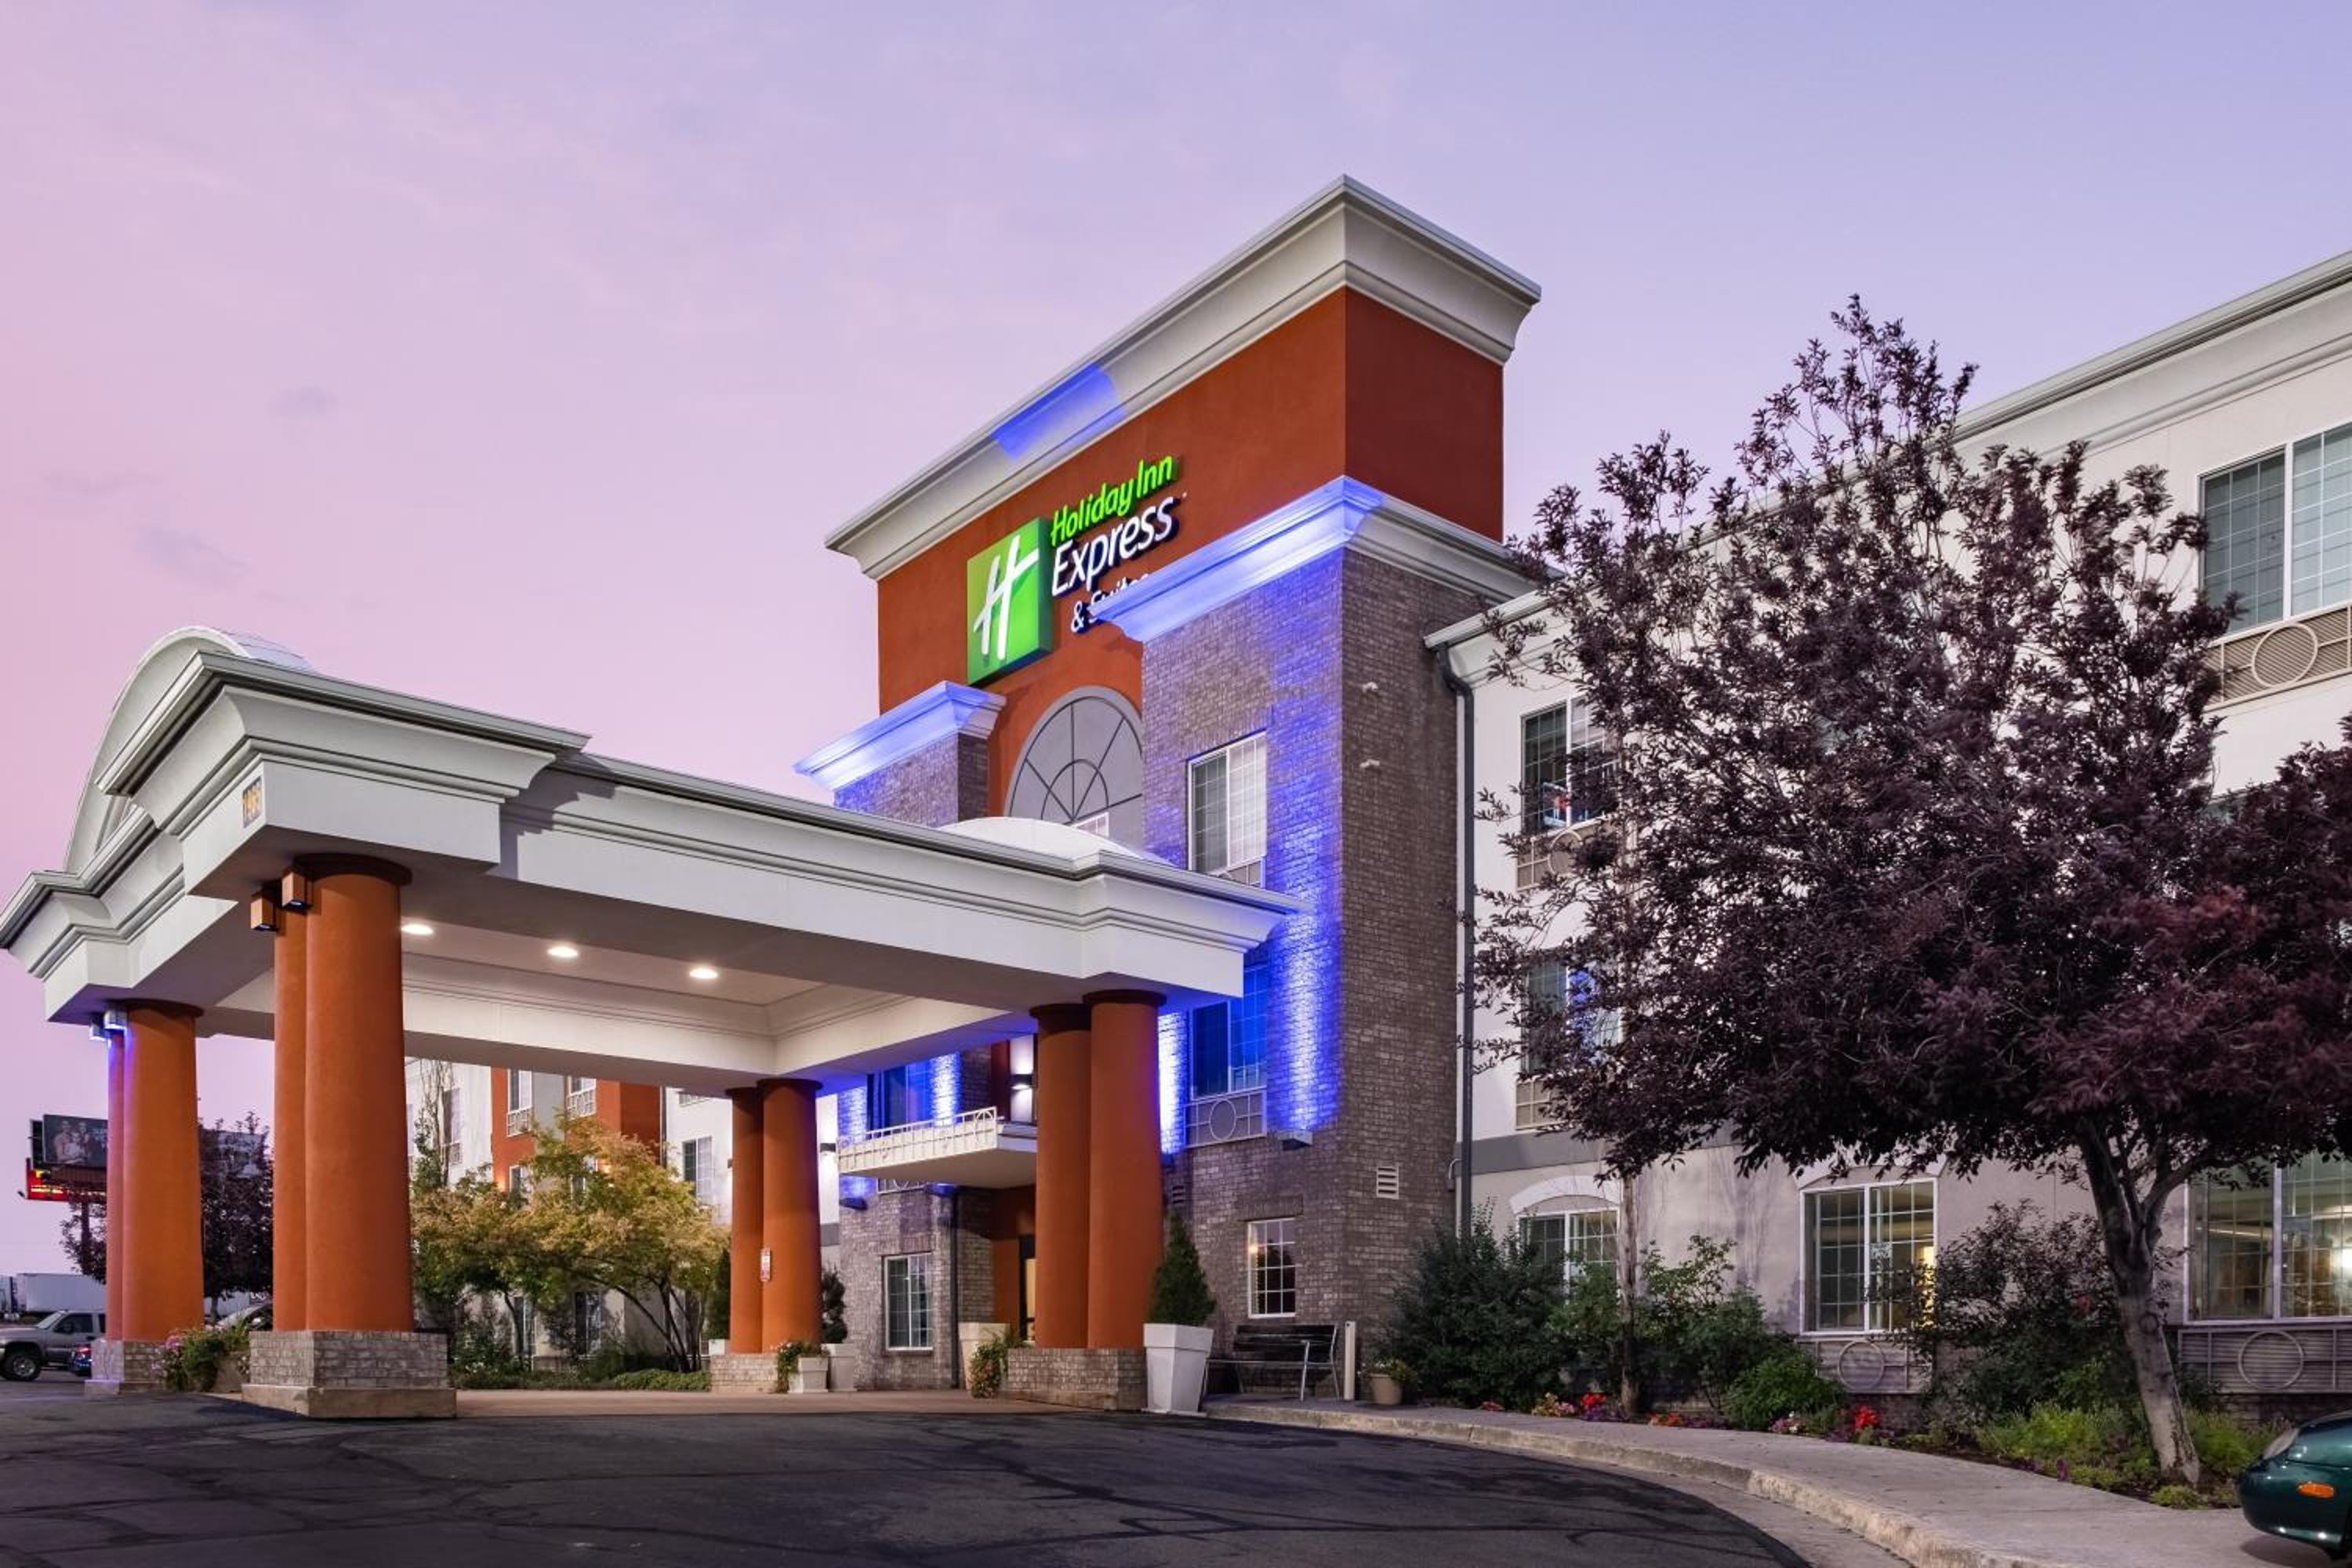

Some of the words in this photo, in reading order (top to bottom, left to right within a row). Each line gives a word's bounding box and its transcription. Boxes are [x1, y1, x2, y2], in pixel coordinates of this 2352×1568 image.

[1050, 478, 1134, 547] Holiday
[1137, 455, 1173, 499] Inn
[1051, 496, 1174, 597] Express
[1071, 601, 1084, 633] &
